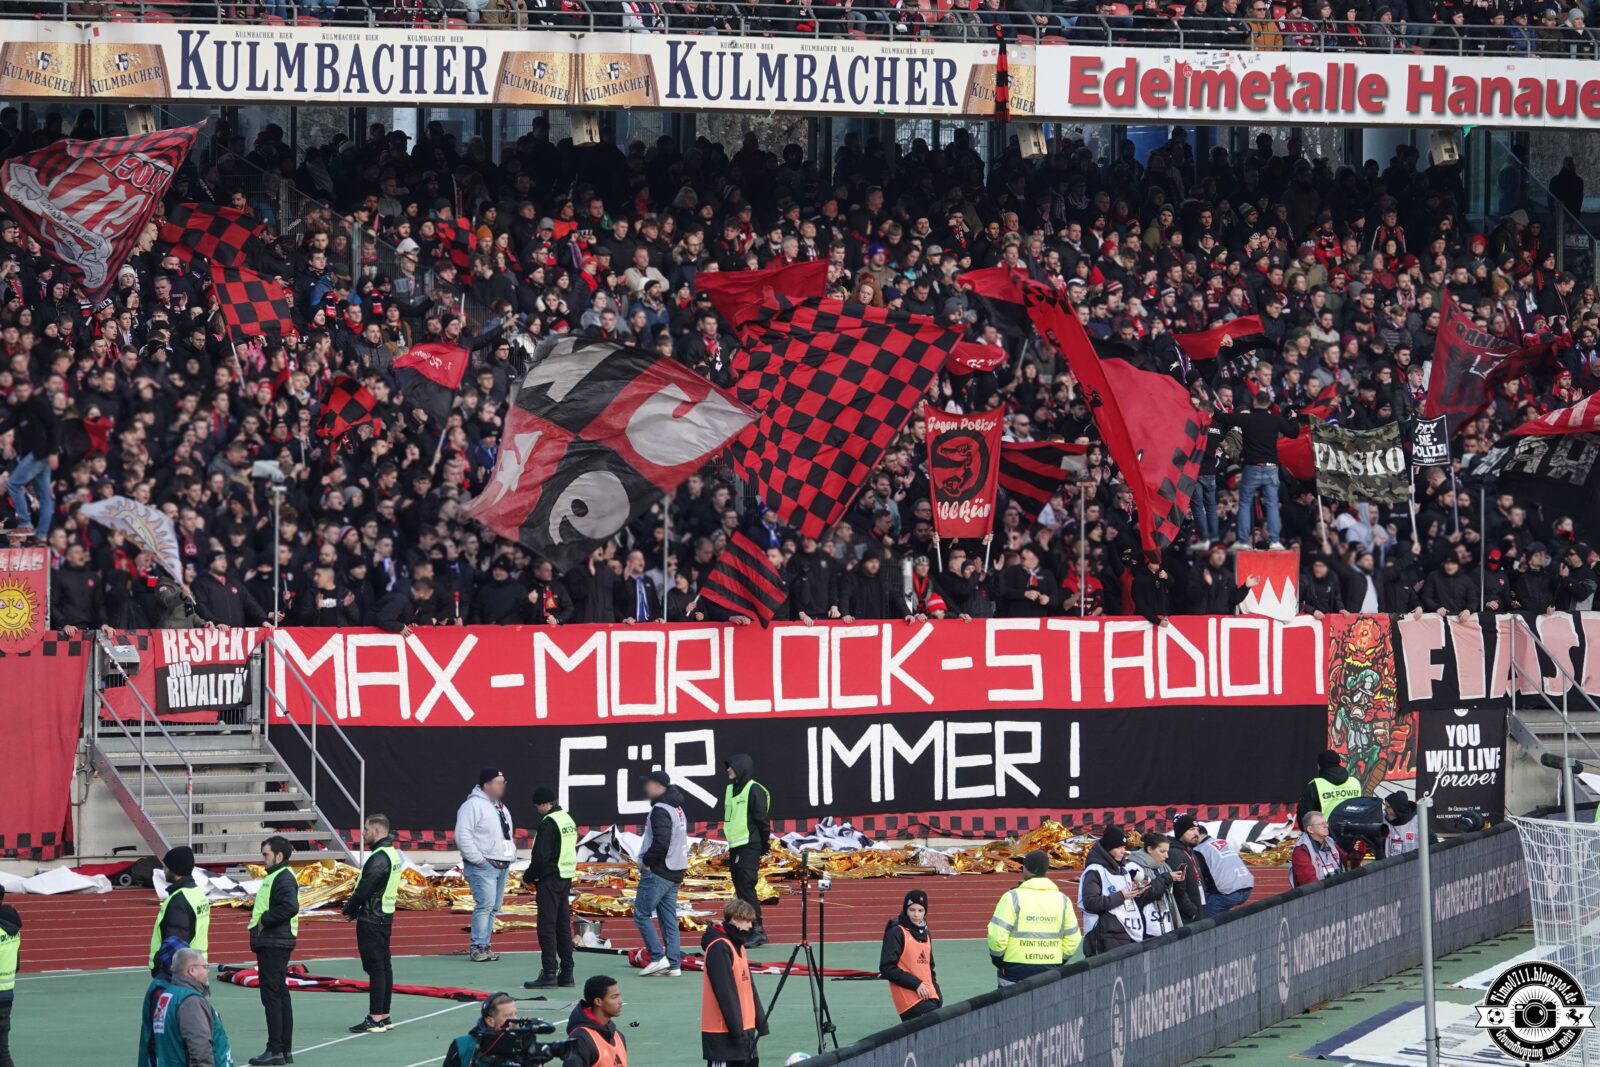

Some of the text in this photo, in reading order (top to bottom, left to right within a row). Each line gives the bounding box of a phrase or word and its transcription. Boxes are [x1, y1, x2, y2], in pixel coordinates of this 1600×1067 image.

[235, 31, 274, 39] KULMBACHER
[322, 33, 360, 41] KULMBACHER
[407, 34, 446, 42] KULMBACHER
[801, 44, 837, 52] KULMBACHER
[881, 46, 917, 54] KULMBACHER
[3, 61, 76, 94] KULMBACHER
[177, 30, 488, 95] KULMBACHER
[666, 40, 958, 106] KULMBACHER
[89, 65, 161, 95] KULMBACHER
[503, 70, 571, 102] KULMBACHER
[1068, 54, 1388, 113] Edelmetalle
[971, 82, 1035, 113] KULMCHER
[928, 417, 958, 433] Gegen
[1418, 434, 1433, 446] DIE
[1412, 443, 1447, 458] POLIZEI
[937, 498, 991, 523] illkür
[161, 627, 259, 664] RESPEKT
[168, 661, 192, 679] UND
[166, 667, 248, 708] RIVALITÄ
[1445, 724, 1481, 748] YOU
[558, 728, 719, 815] FÜR
[807, 720, 1042, 806] IMMER
[1425, 749, 1465, 773] WILL
[1423, 764, 1497, 799] forever
[1293, 899, 1401, 976] NÜRNBERGER VERSICHERUNG
[1130, 953, 1257, 1042] NÜRNBERGER VERSICHERUNG
